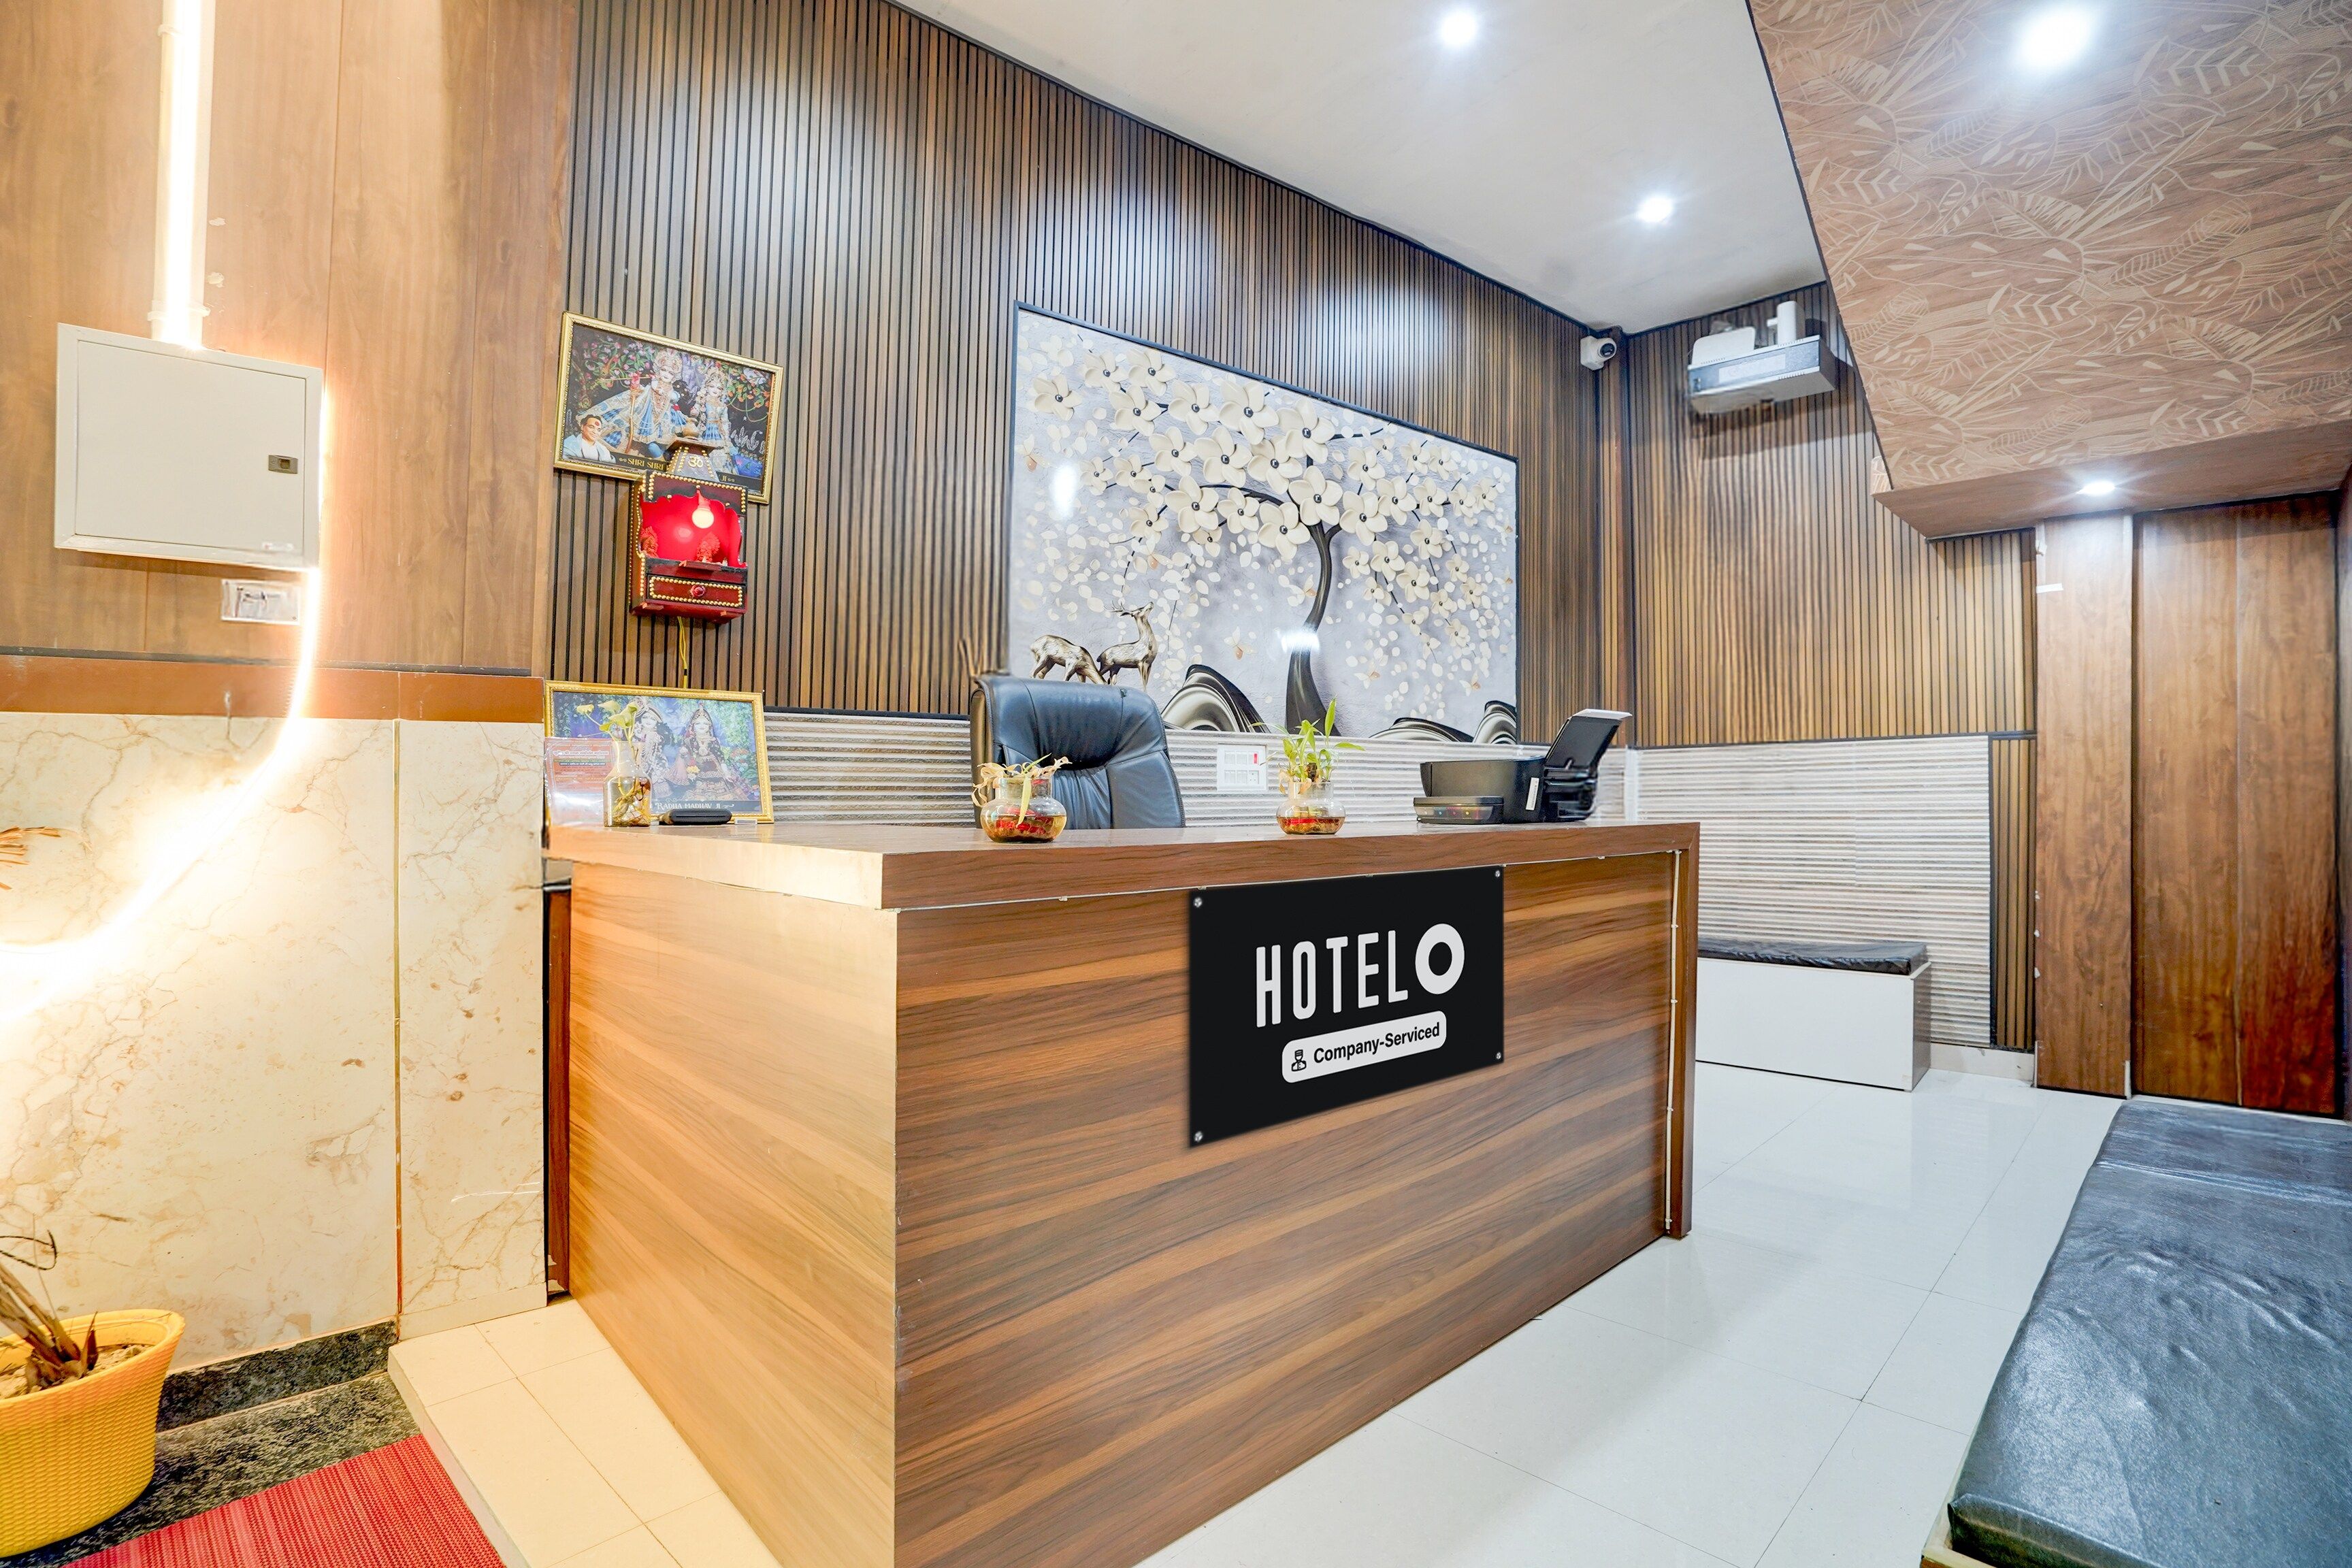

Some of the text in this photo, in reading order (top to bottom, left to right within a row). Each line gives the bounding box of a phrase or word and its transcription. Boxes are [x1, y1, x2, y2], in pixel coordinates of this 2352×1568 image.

[627, 457, 645, 467] SHRI
[647, 461, 664, 471] SHRI
[655, 802, 683, 811] RADHA
[1256, 930, 1408, 1028] HOTEL
[1313, 1022, 1440, 1064] Company-Serviced
